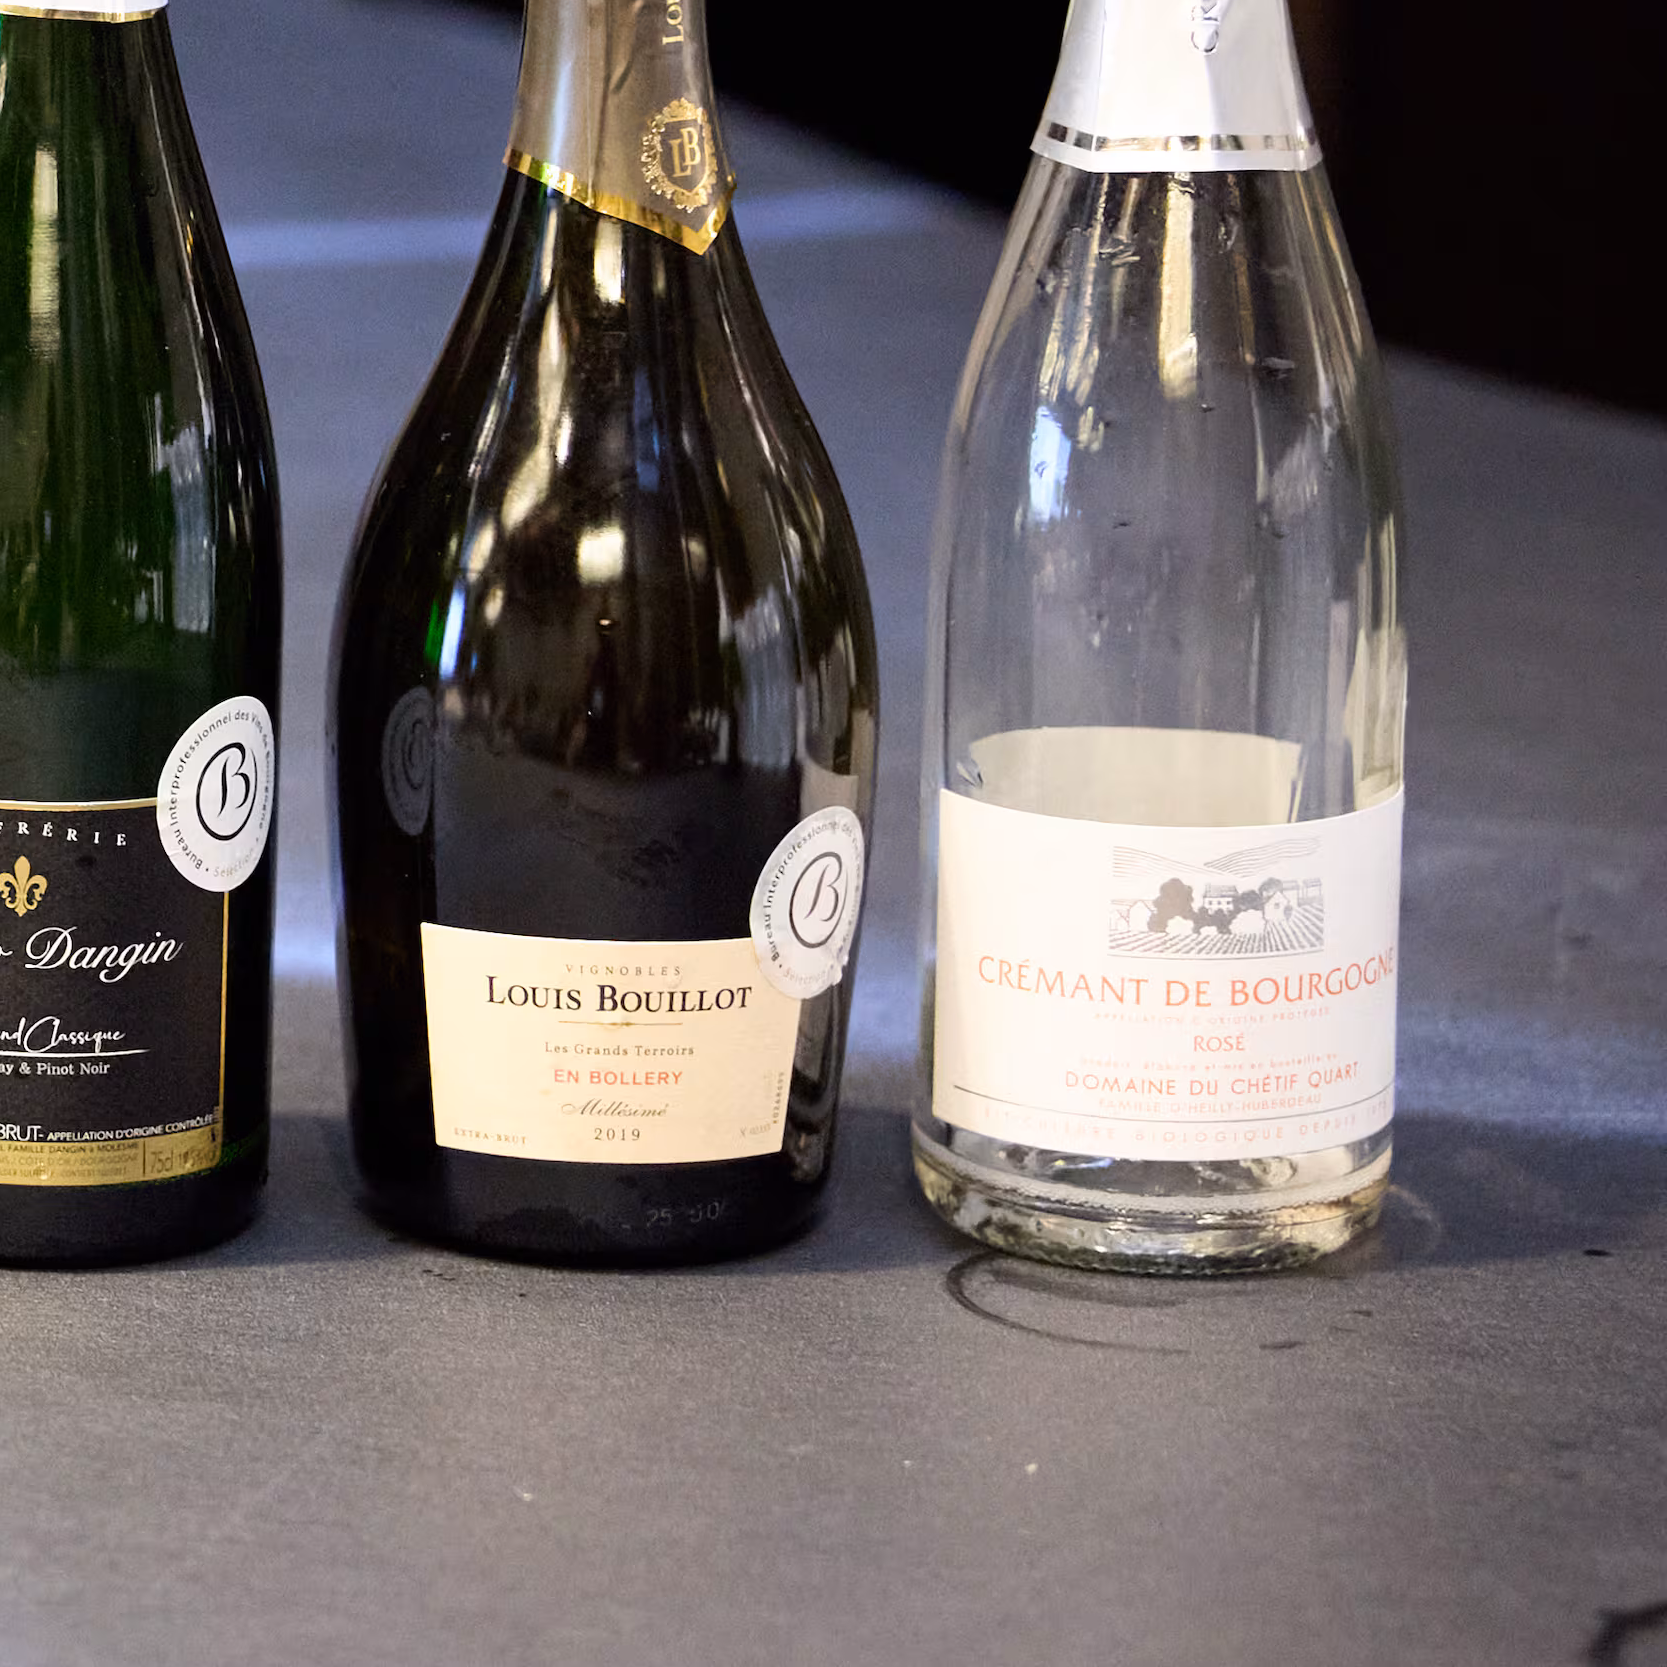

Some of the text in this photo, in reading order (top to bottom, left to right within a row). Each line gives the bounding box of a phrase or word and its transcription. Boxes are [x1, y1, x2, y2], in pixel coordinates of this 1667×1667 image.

[233, 709, 250, 722] des
[168, 711, 232, 827] Interprofessionnel
[173, 828, 203, 870] Bureau
[762, 819, 841, 909] Interprofessionnel
[763, 912, 780, 962] Bureau
[24, 926, 185, 983] Dangin
[564, 963, 683, 977] VIGNOBLES
[977, 946, 1395, 1008] CRÉMANT DE BOURGOGNE
[485, 975, 753, 1013] LOUIS BOUILLOT
[22, 1015, 127, 1054] Classique
[1193, 1032, 1246, 1053] ROSÉ
[545, 1041, 695, 1057] Les Grands Terroirs
[19, 1061, 31, 1074] &
[36, 1061, 75, 1075] Pinot
[79, 1060, 110, 1075] Noir
[554, 1068, 684, 1086] EN BOLLERY
[1065, 1060, 1359, 1097] DOMAINE DU CHÉTIF QUART
[47, 1131, 113, 1142] APPELLATION
[115, 1125, 163, 1140] D'ORIGINE
[454, 1126, 527, 1144] EXTRA-BRUT
[593, 1126, 642, 1142] 2019
[48, 1145, 86, 1154] DANGIN
